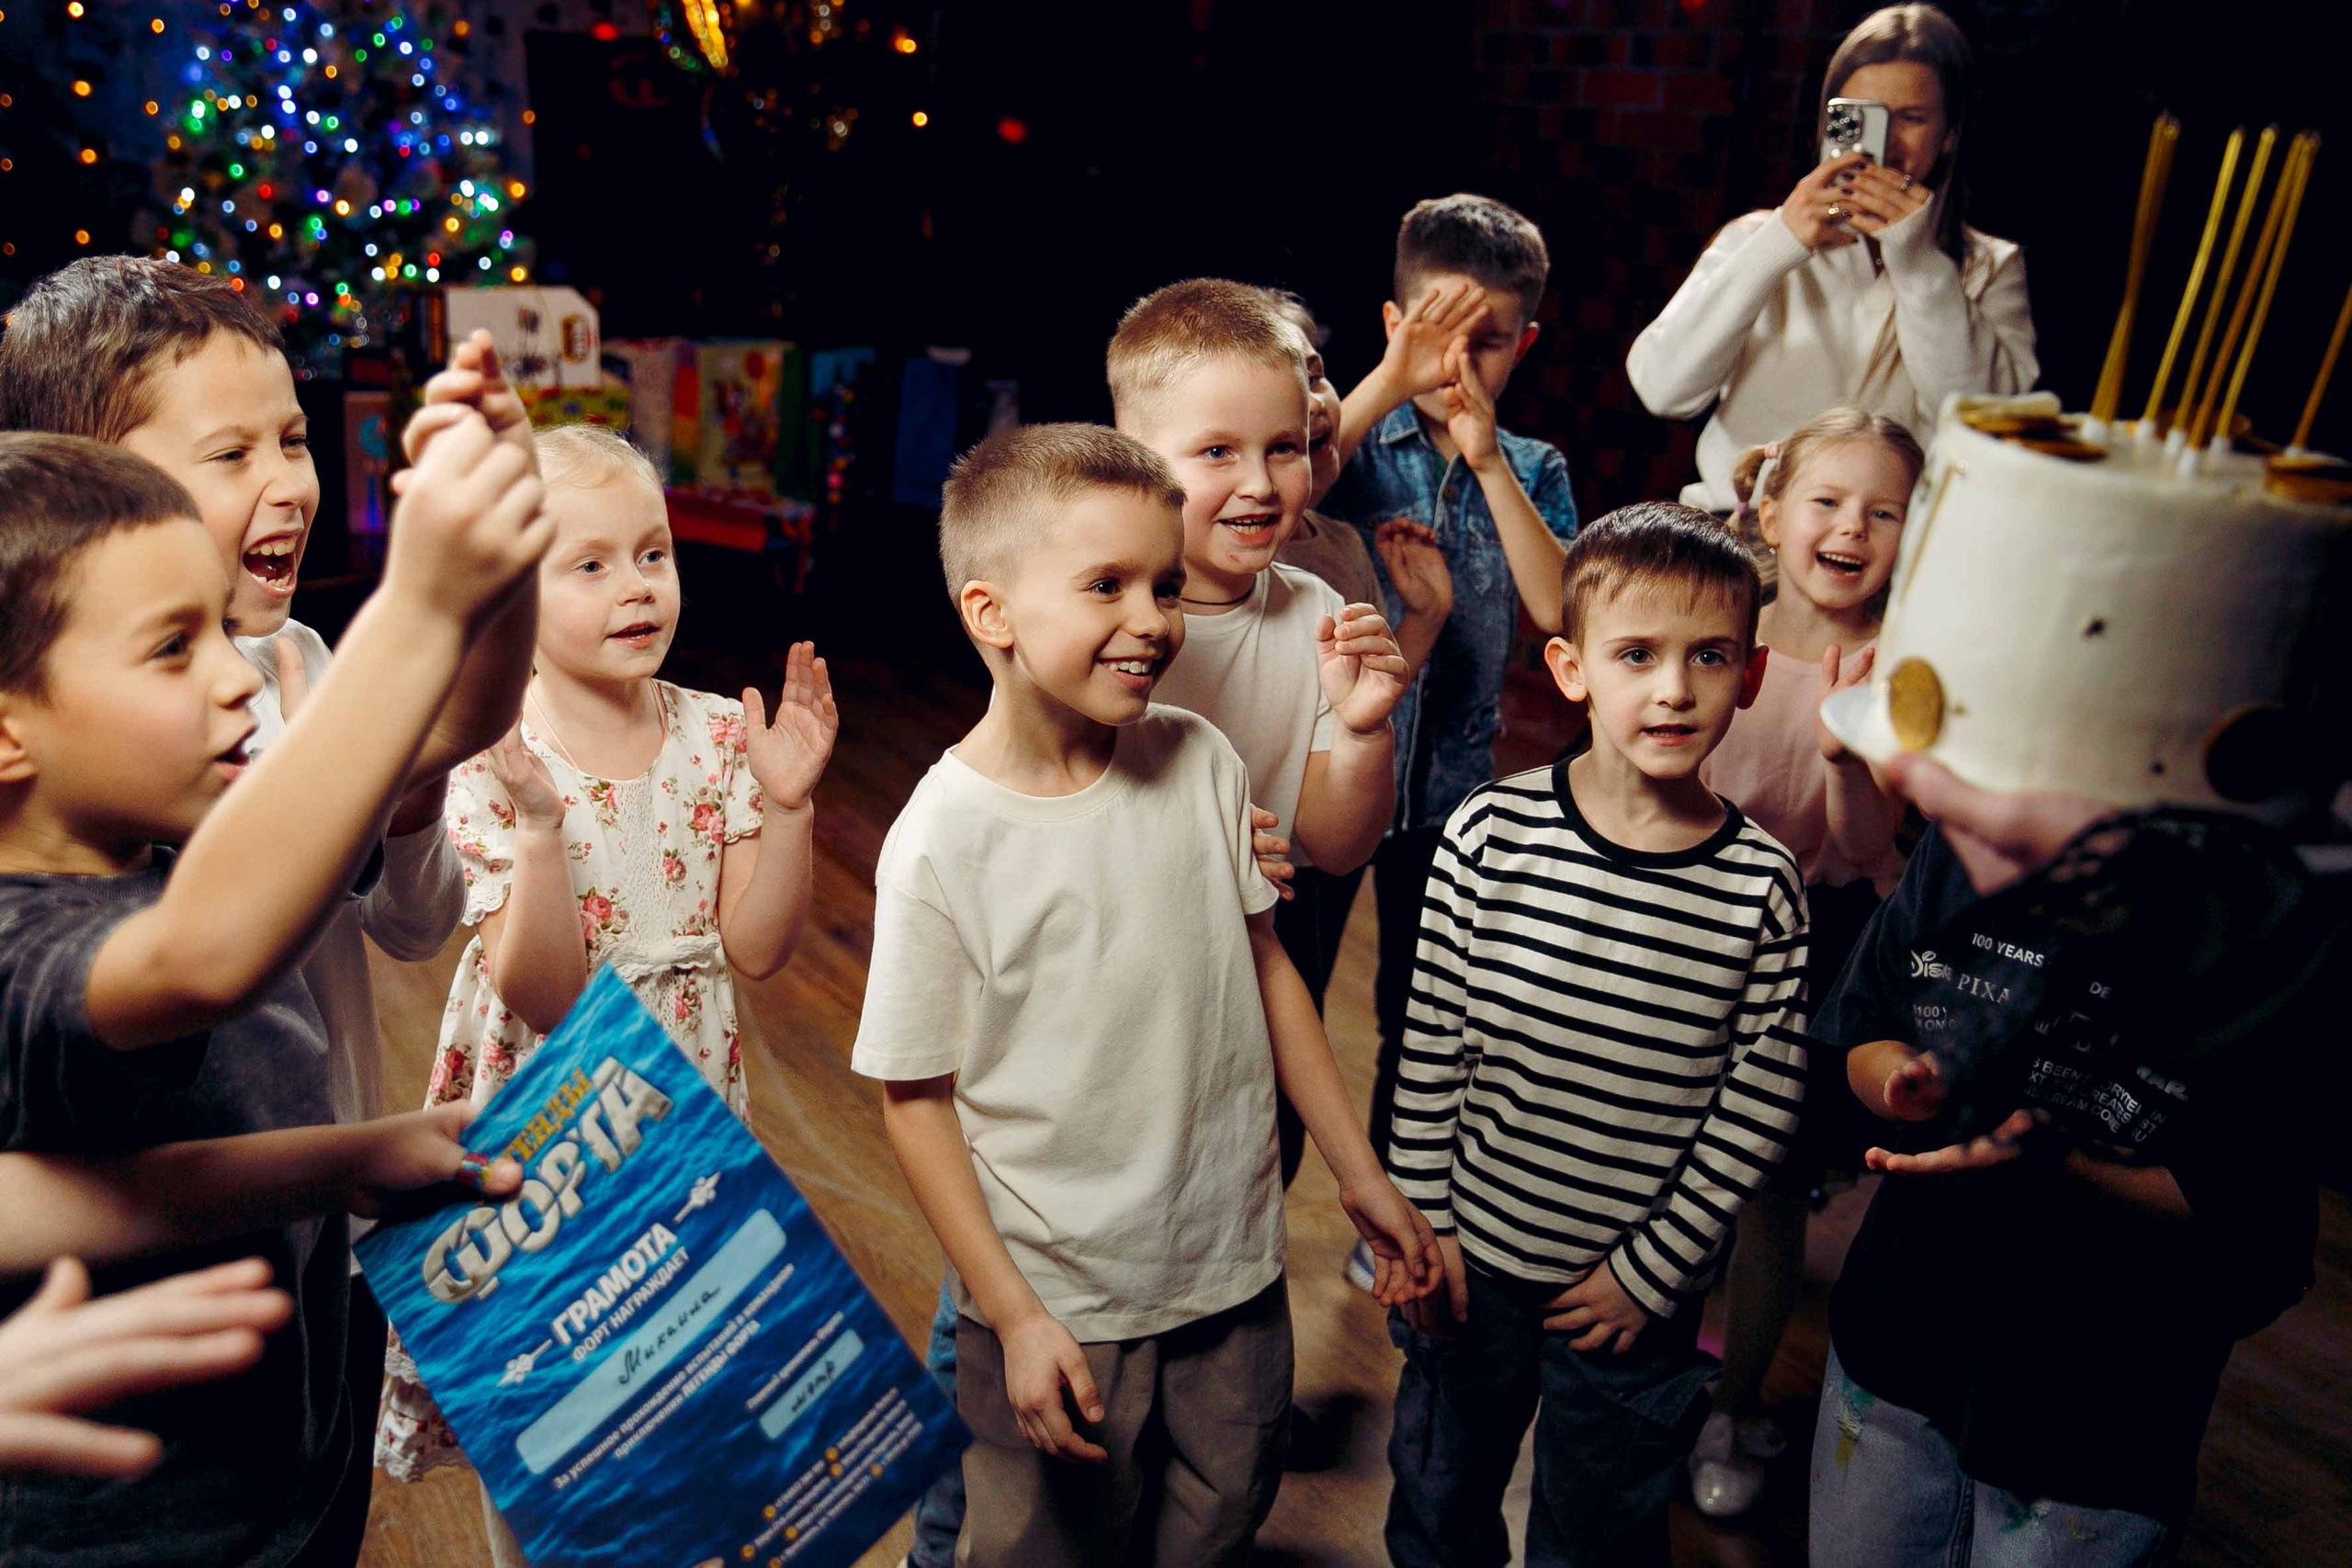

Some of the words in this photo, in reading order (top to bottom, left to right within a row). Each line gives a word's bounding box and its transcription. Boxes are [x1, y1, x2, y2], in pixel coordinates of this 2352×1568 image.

[1972, 932, 1993, 950] 100
[1996, 941, 2045, 967] YEARS
[503, 1066, 594, 1163] ГЕНДЫ
[2041, 1060, 2082, 1081] BEEN
[424, 1056, 673, 1302] ФОРТА
[549, 1220, 679, 1347] ГРАМОТА
[571, 1325, 613, 1363] ФОРТ
[610, 1246, 690, 1331] НАГРАЖДАЕТ
[553, 1472, 571, 1490] За
[568, 1430, 620, 1482] успешное
[619, 1369, 686, 1439] прохождение
[685, 1321, 738, 1376] испытаний
[683, 1349, 729, 1403] ЛЕГЕНДЫ
[726, 1319, 761, 1357] ФОРТА
